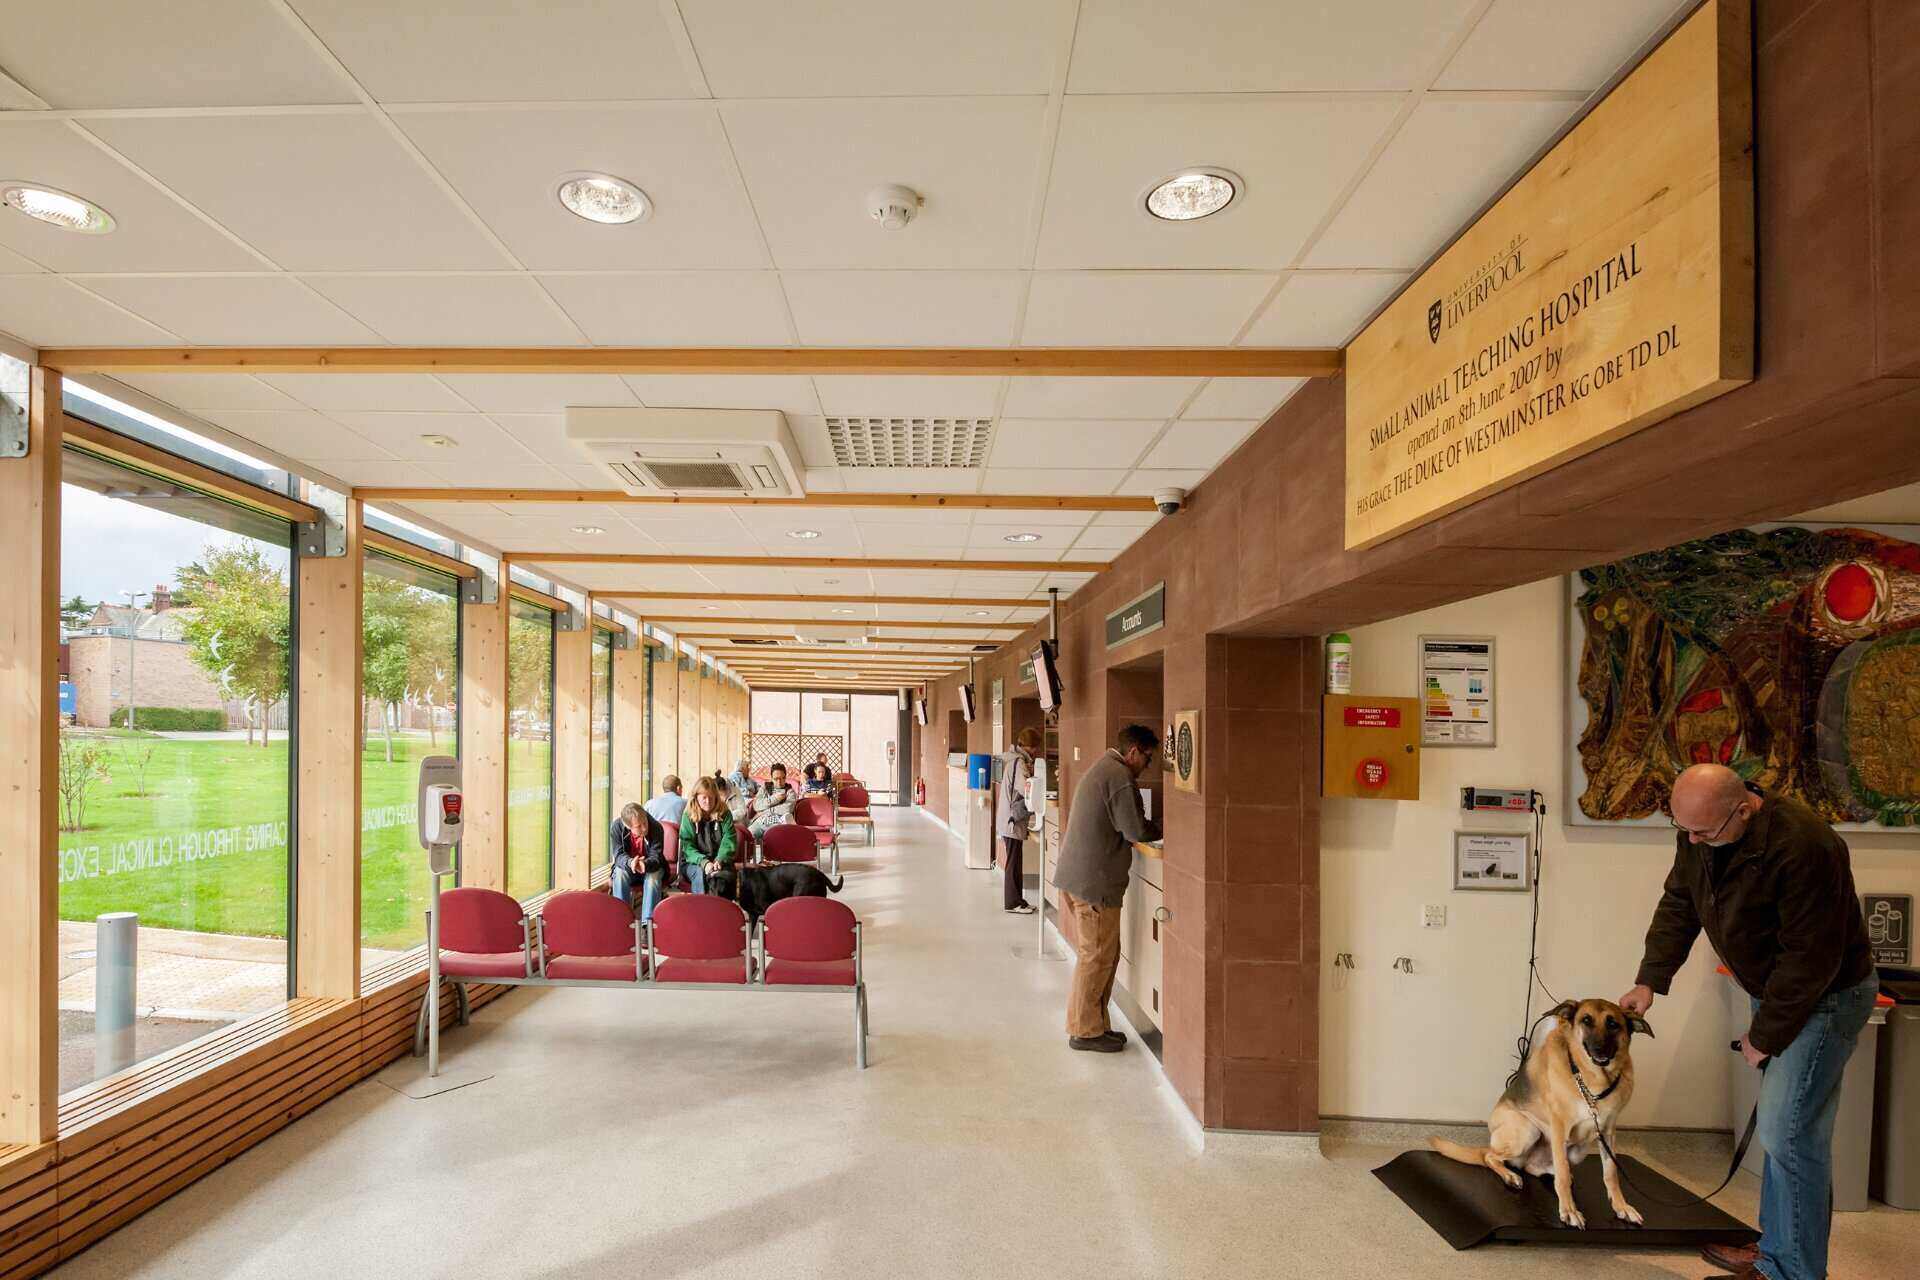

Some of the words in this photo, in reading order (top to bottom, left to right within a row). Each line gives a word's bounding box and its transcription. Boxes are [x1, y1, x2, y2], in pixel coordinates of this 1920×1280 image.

[1369, 411, 1401, 452] SMALL
[1403, 377, 1450, 431] ANIMAL
[1453, 316, 1534, 394] TEACHING
[1541, 242, 1642, 337] HOSPITAL
[1448, 250, 1526, 329] LIVERPOOL
[1356, 494, 1369, 516] HIS
[1369, 483, 1392, 509] GRACE
[1393, 467, 1413, 497] THE
[1415, 450, 1444, 485] DUKE
[1446, 440, 1462, 468] OF
[1465, 383, 1567, 457] WESTMINSTER
[1570, 373, 1590, 404] KG
[1593, 353, 1624, 390] OBE
[1627, 340, 1652, 371] TD
[1657, 324, 1681, 358] DL
[1407, 417, 1439, 461] opened
[1442, 415, 1455, 435] on
[1459, 396, 1476, 425] 8th
[1478, 382, 1506, 414] June
[1510, 354, 1542, 395] 2007
[1546, 346, 1562, 379] by
[1122, 609, 1142, 632] Accounts
